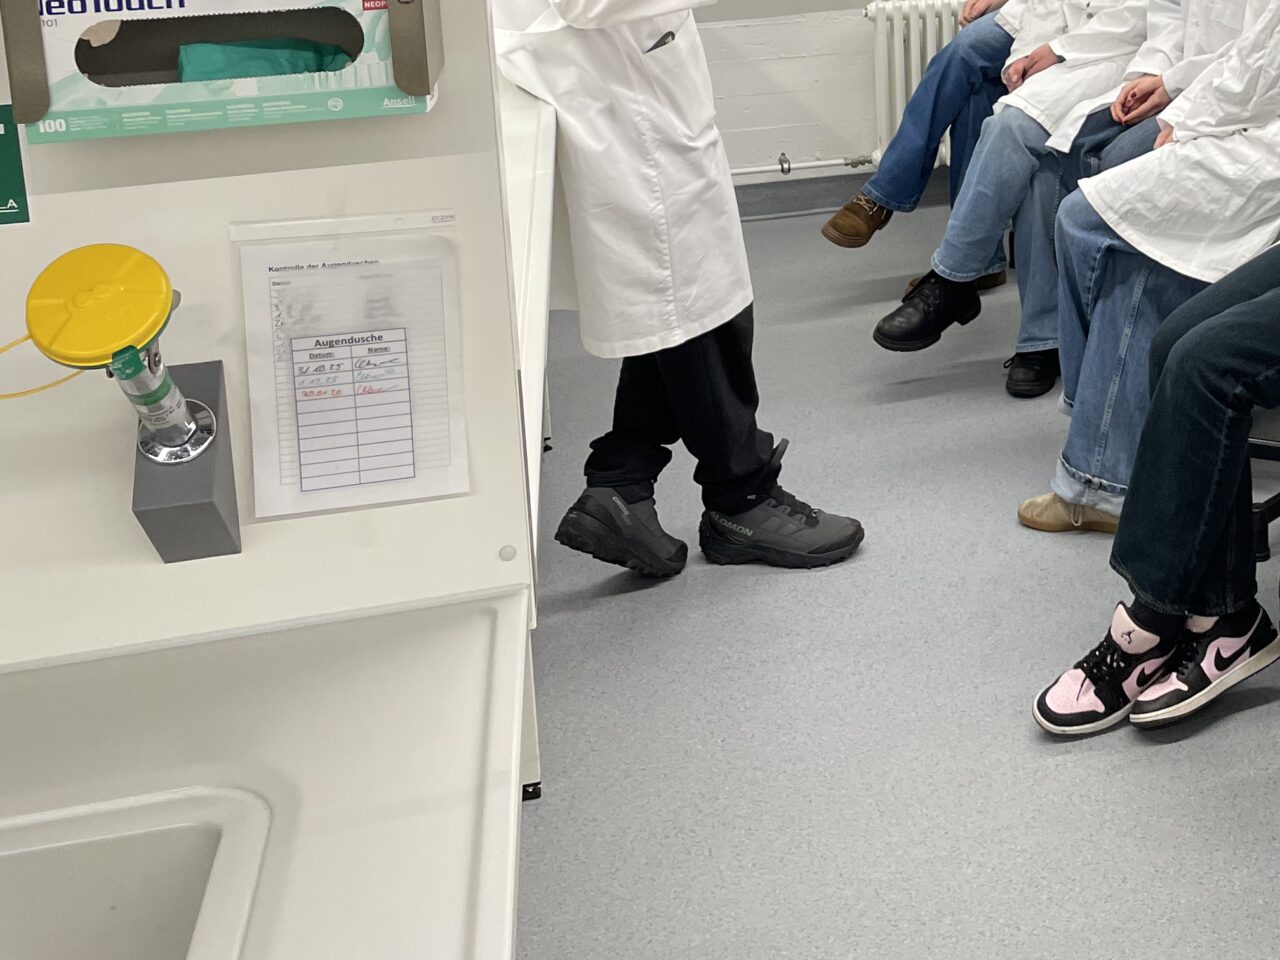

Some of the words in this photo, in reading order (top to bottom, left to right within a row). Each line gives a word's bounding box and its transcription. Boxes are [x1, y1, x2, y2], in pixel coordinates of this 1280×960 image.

[37, 119, 67, 133] 100
[268, 263, 304, 273] Kontrolle
[306, 262, 319, 270] der
[314, 333, 384, 348] Augendusche
